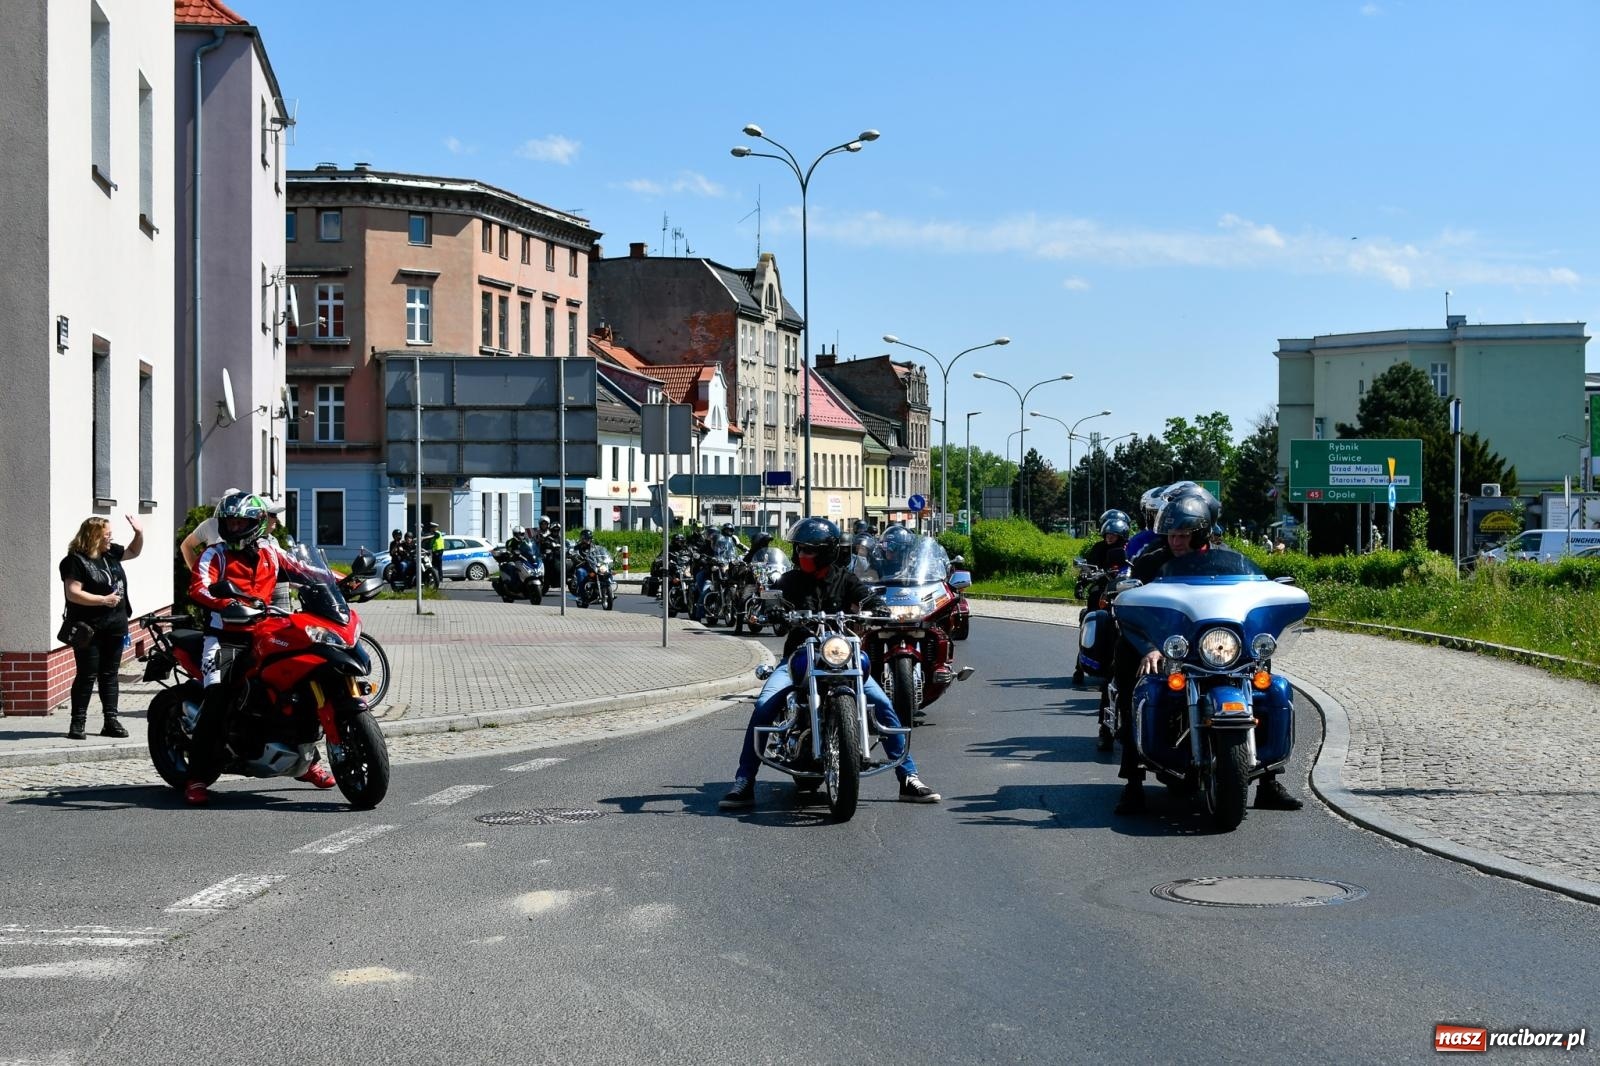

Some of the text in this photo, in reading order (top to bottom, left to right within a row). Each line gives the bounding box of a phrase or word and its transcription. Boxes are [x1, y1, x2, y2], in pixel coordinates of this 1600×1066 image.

[1329, 442, 1359, 452] Rybnik
[1328, 453, 1362, 462] Gliwice
[1355, 465, 1380, 473] Miejski
[1328, 490, 1356, 499] Opole
